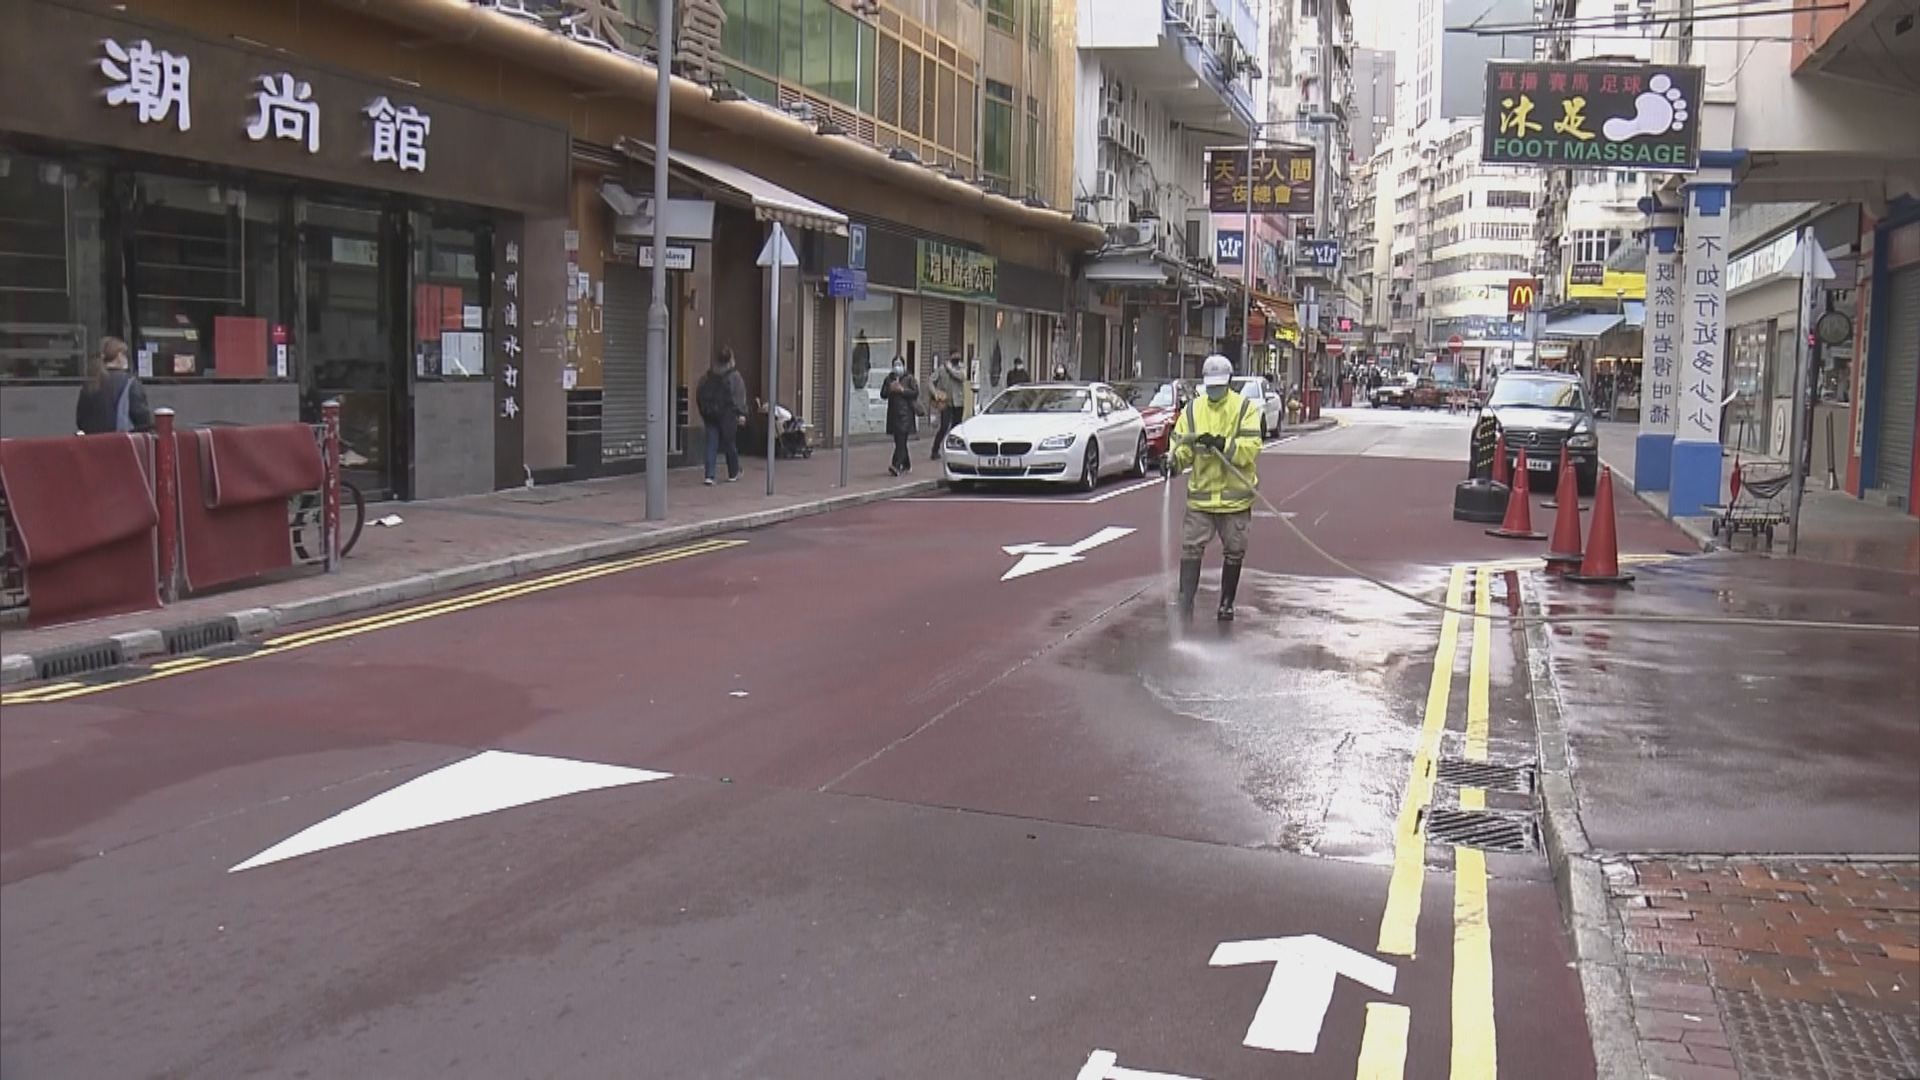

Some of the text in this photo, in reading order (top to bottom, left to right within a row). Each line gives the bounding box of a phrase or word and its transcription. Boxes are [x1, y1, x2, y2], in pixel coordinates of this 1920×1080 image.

[101, 38, 431, 173] 潮尚館
[1500, 94, 1596, 140] 沐足
[1494, 138, 1687, 163] FOOT MASSAGE
[1232, 184, 1292, 204] 夜總會
[851, 229, 863, 262] P
[1219, 238, 1242, 250] VIP
[1315, 245, 1337, 257] VIP
